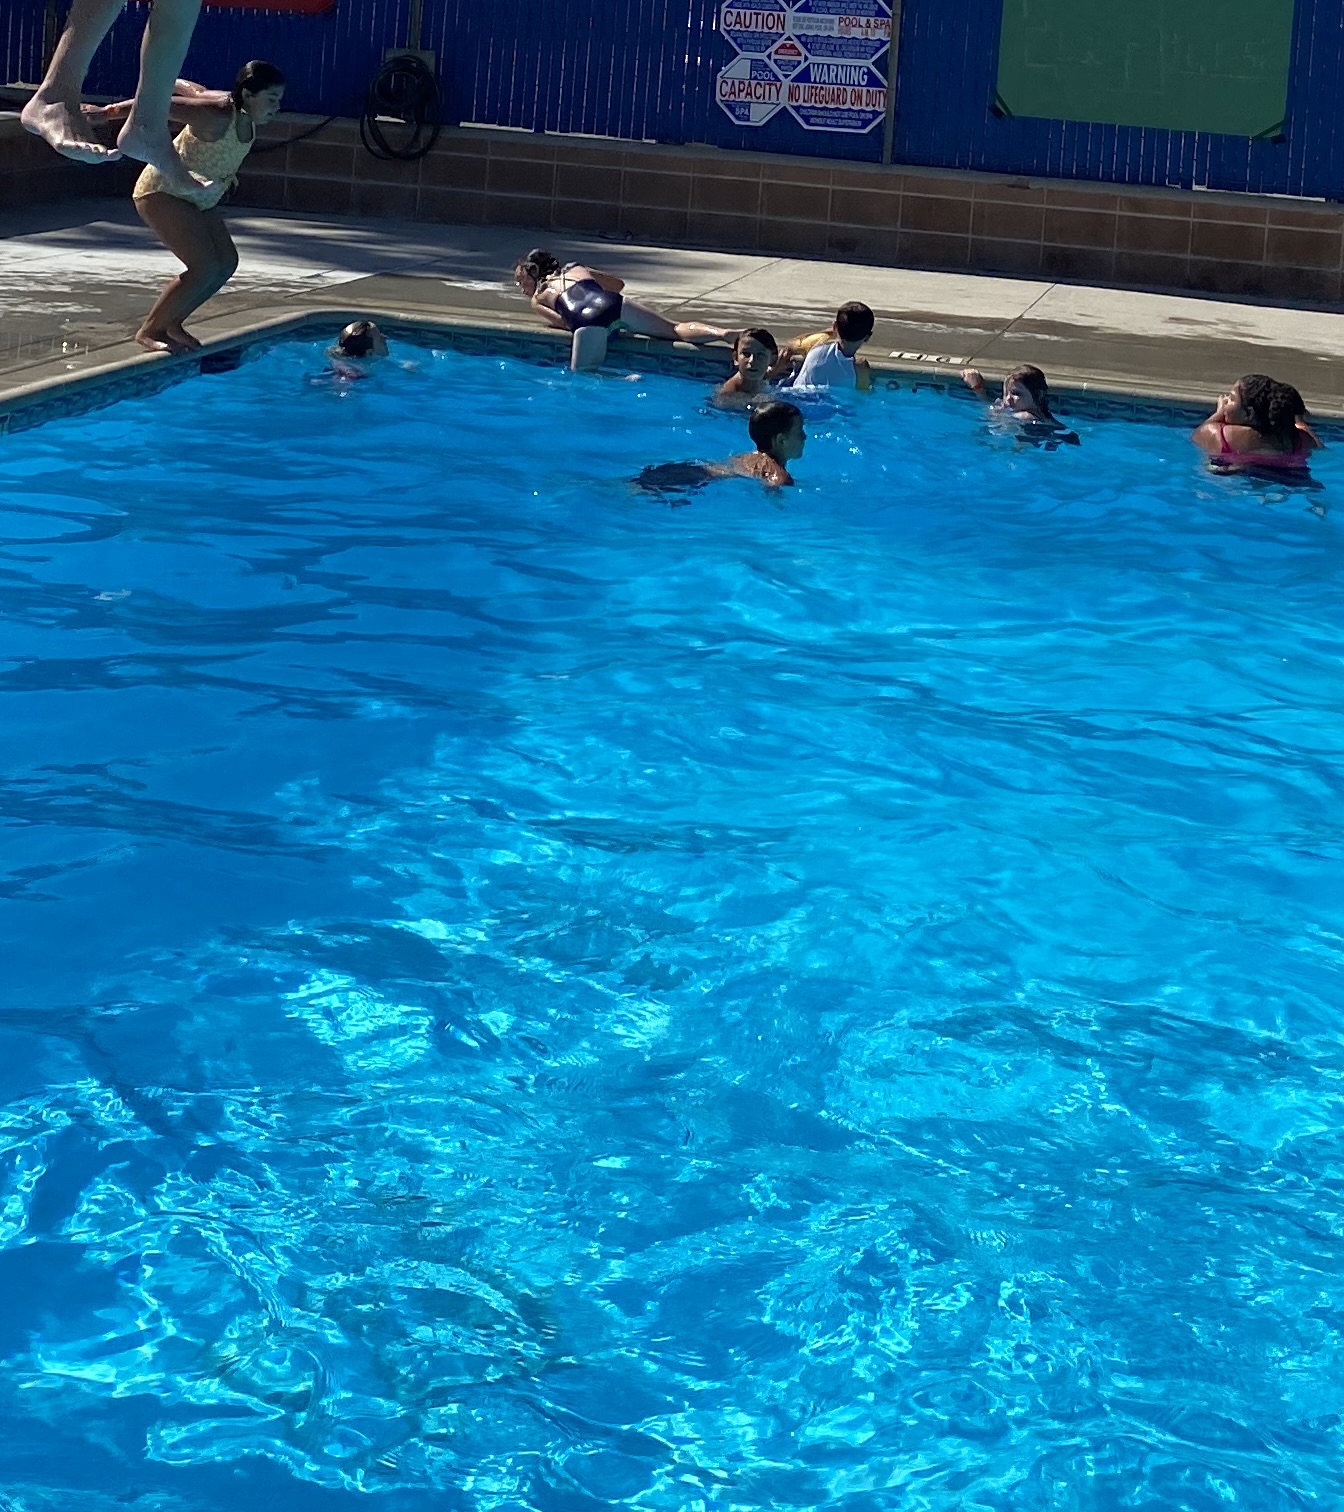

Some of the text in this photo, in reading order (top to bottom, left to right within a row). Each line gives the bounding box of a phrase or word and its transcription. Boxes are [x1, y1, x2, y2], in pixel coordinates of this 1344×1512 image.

[723, 9, 786, 31] CAUTION
[838, 16, 863, 28] POOL
[865, 18, 872, 29] &
[873, 19, 891, 30] SPA
[751, 70, 775, 80] POOL
[809, 63, 868, 86] WARNING
[719, 79, 783, 102] CAPACITY
[788, 84, 888, 108] NO LIFEGUARD ON DUTY
